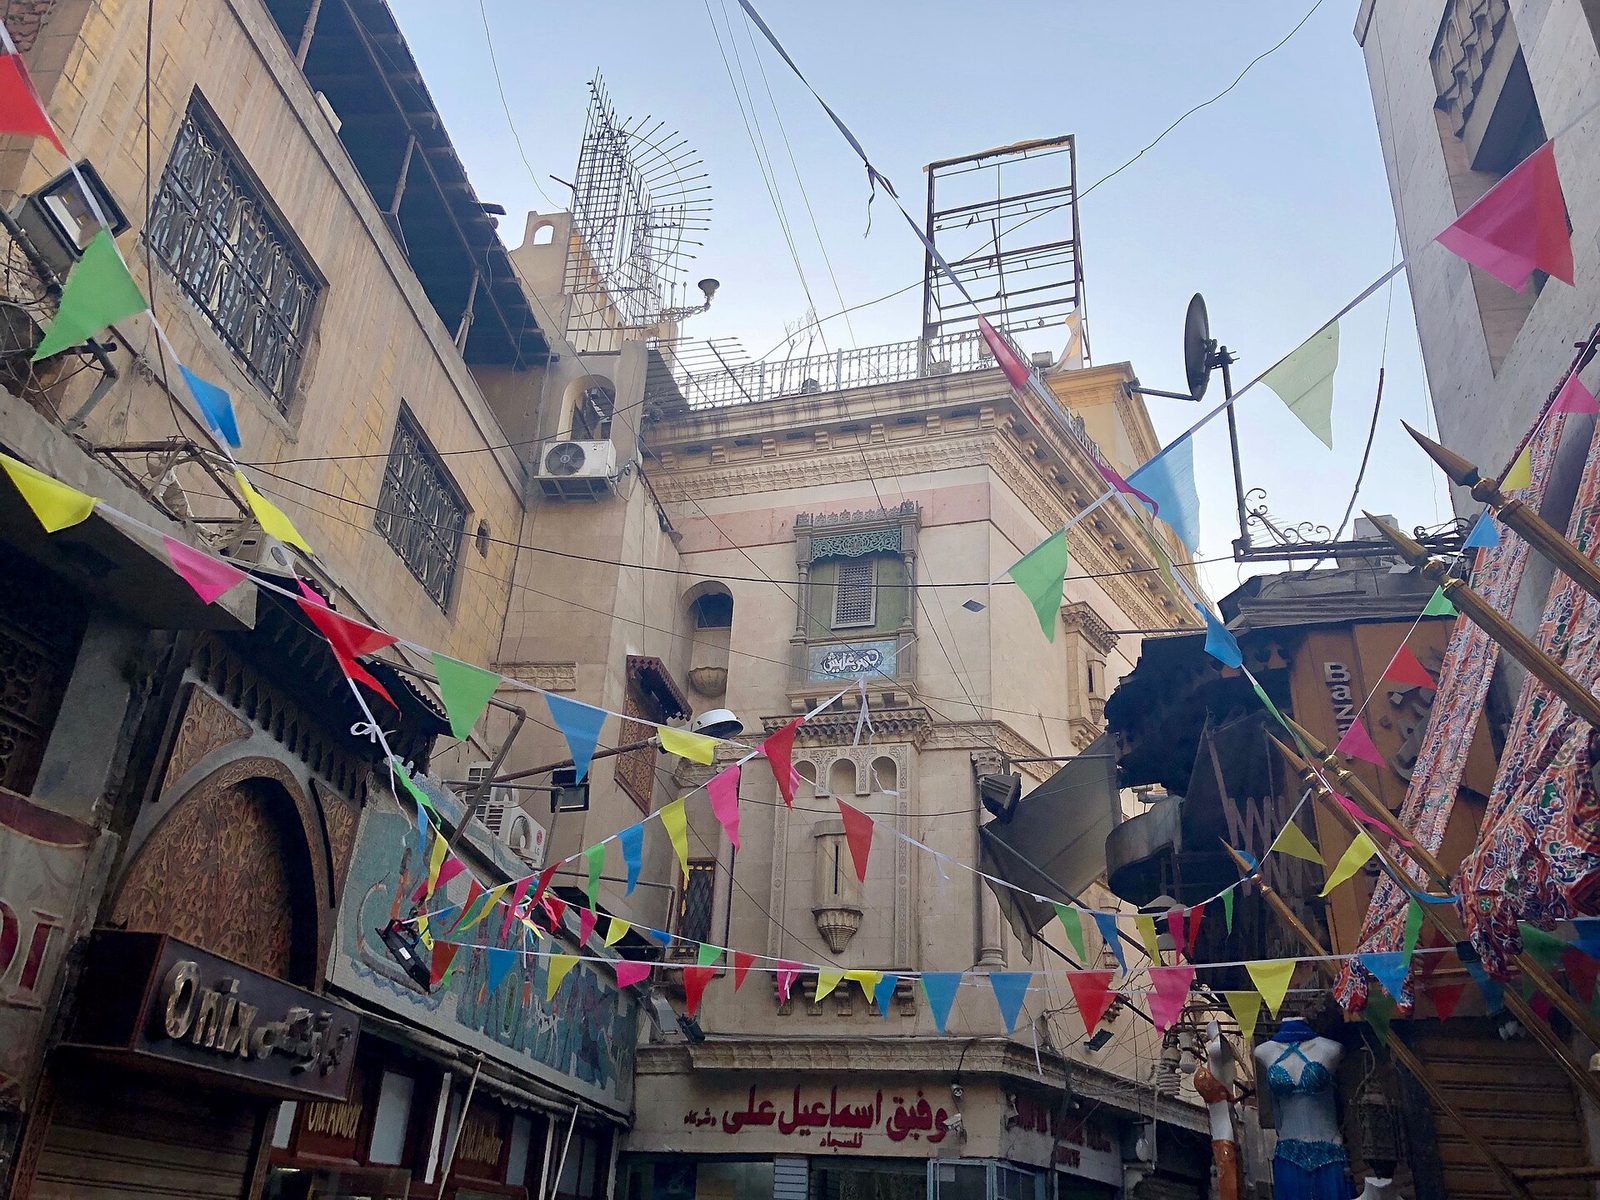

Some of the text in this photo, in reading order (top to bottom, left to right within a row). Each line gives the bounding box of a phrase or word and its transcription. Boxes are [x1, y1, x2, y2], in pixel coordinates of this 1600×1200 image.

[162, 960, 259, 1059] Onix
[721, 1084, 776, 1135] على
[778, 1084, 883, 1138] اسماعيل
[885, 1090, 949, 1143] وفيق
[819, 1131, 864, 1153] للسجاد
